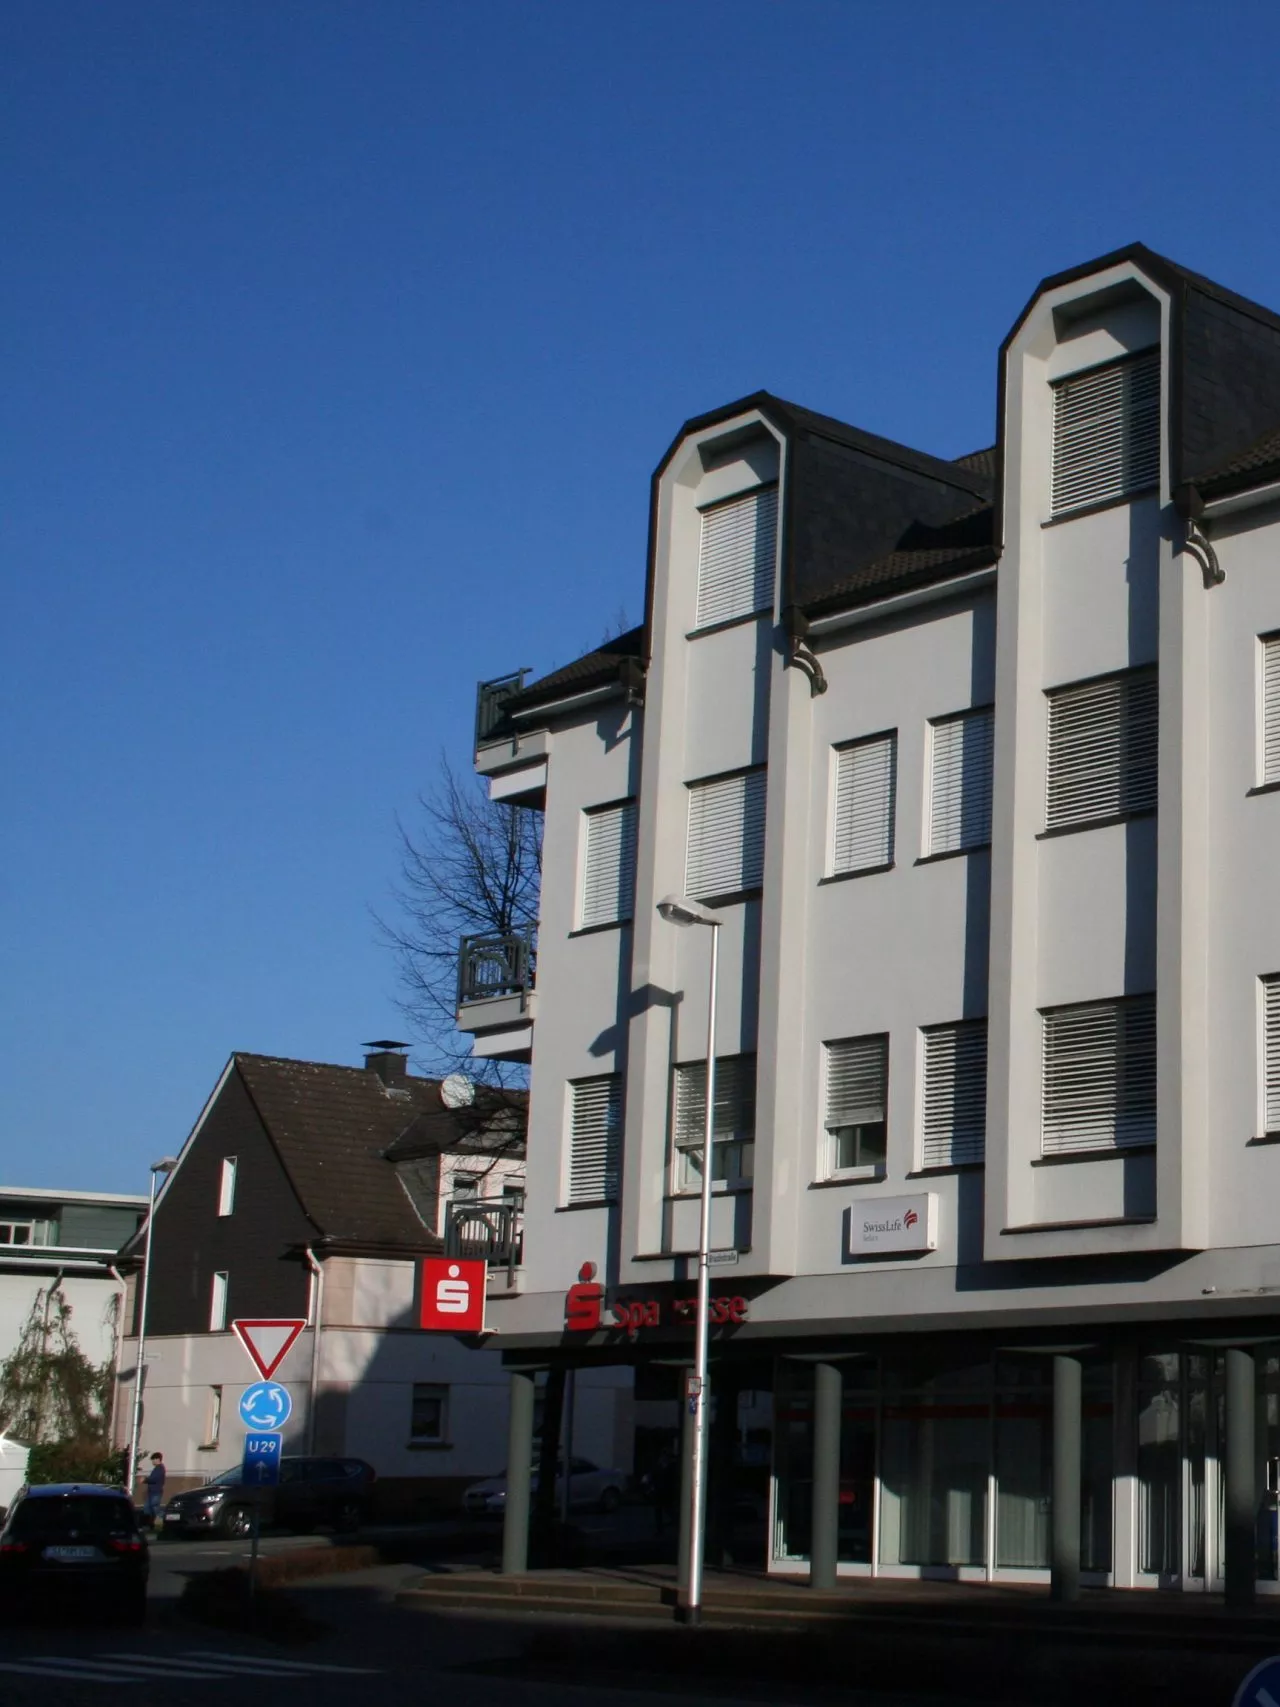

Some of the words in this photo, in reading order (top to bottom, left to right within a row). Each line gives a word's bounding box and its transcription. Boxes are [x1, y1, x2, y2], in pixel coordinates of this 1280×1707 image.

[612, 1296, 748, 1337] Spase
[249, 1440, 259, 1453] U
[260, 1440, 276, 1453] 29
